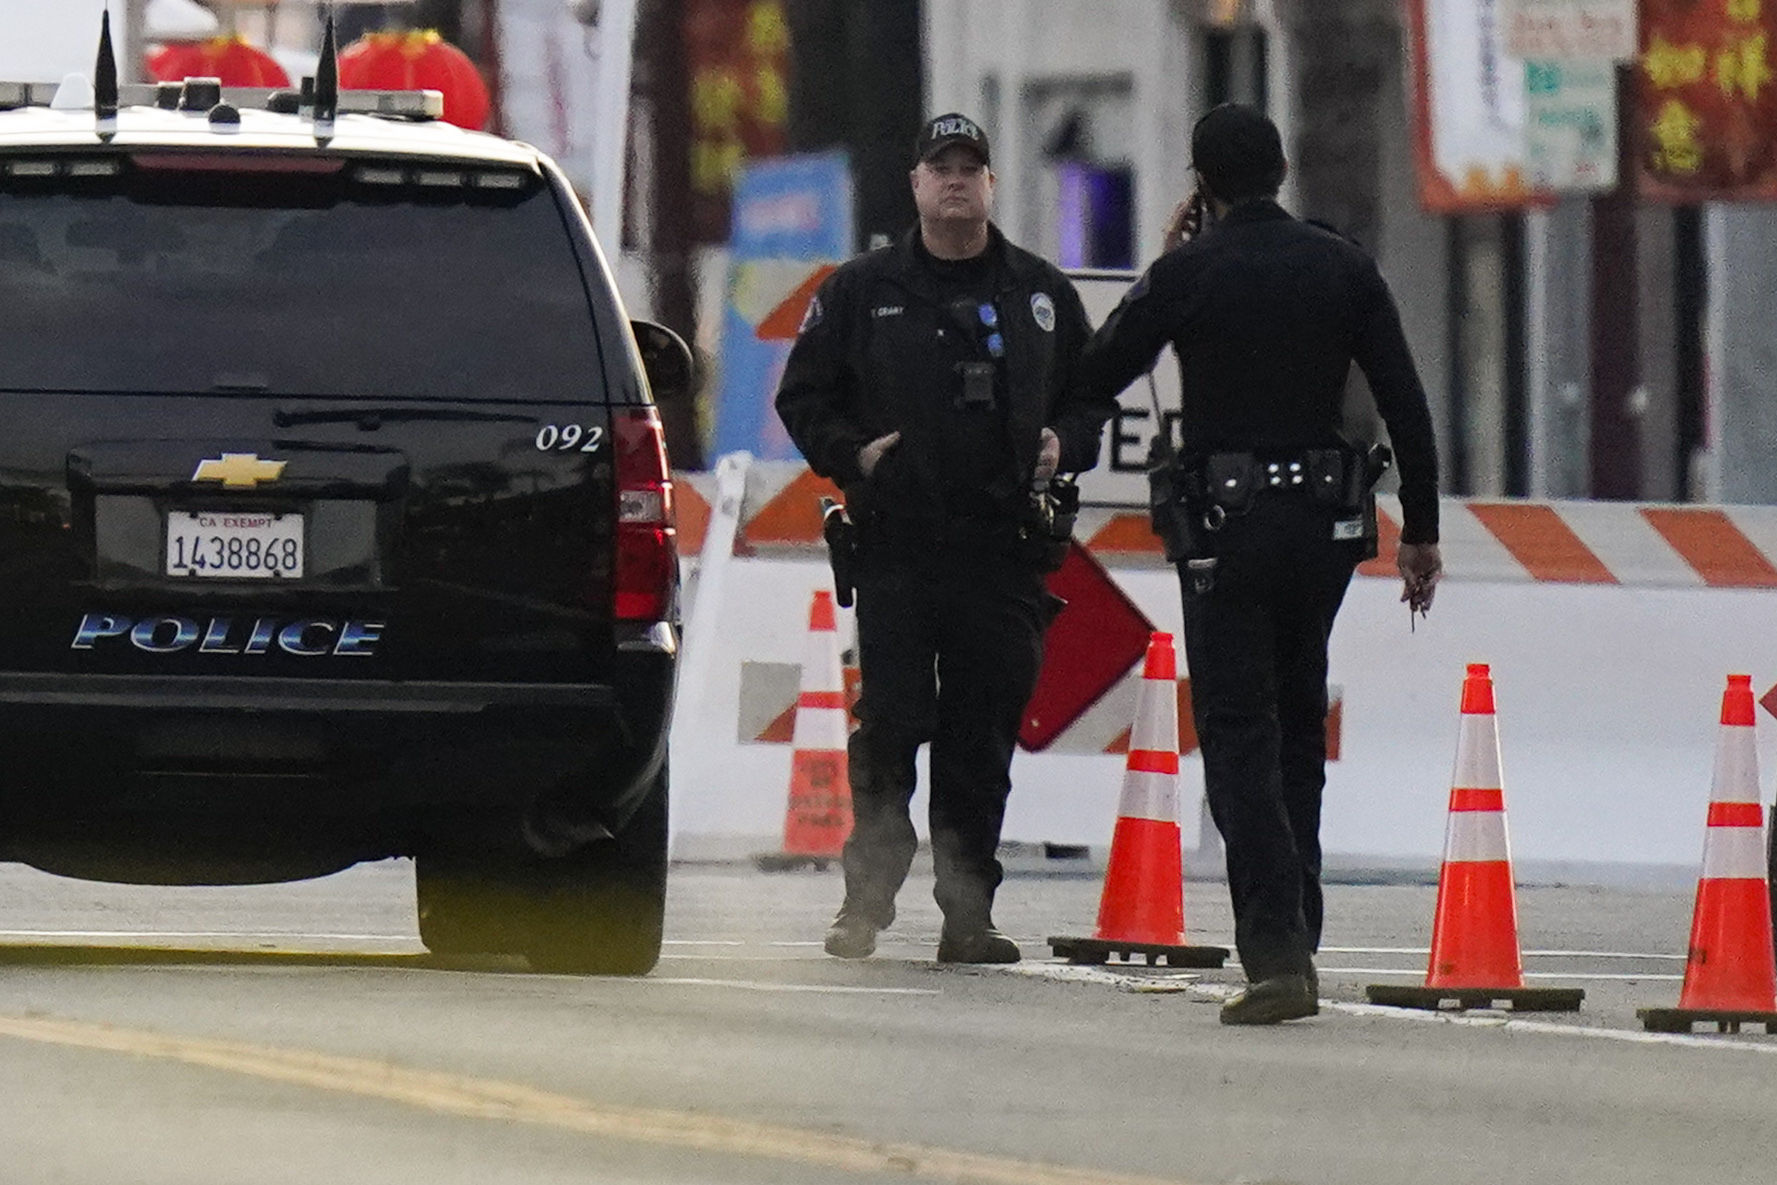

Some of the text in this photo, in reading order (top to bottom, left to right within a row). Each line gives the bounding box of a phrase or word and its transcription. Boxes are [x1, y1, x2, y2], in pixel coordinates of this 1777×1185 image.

[535, 424, 602, 454] 092
[200, 518, 273, 528] CA EXEMPT
[173, 536, 297, 570] 1438868
[70, 613, 386, 656] POLICE
